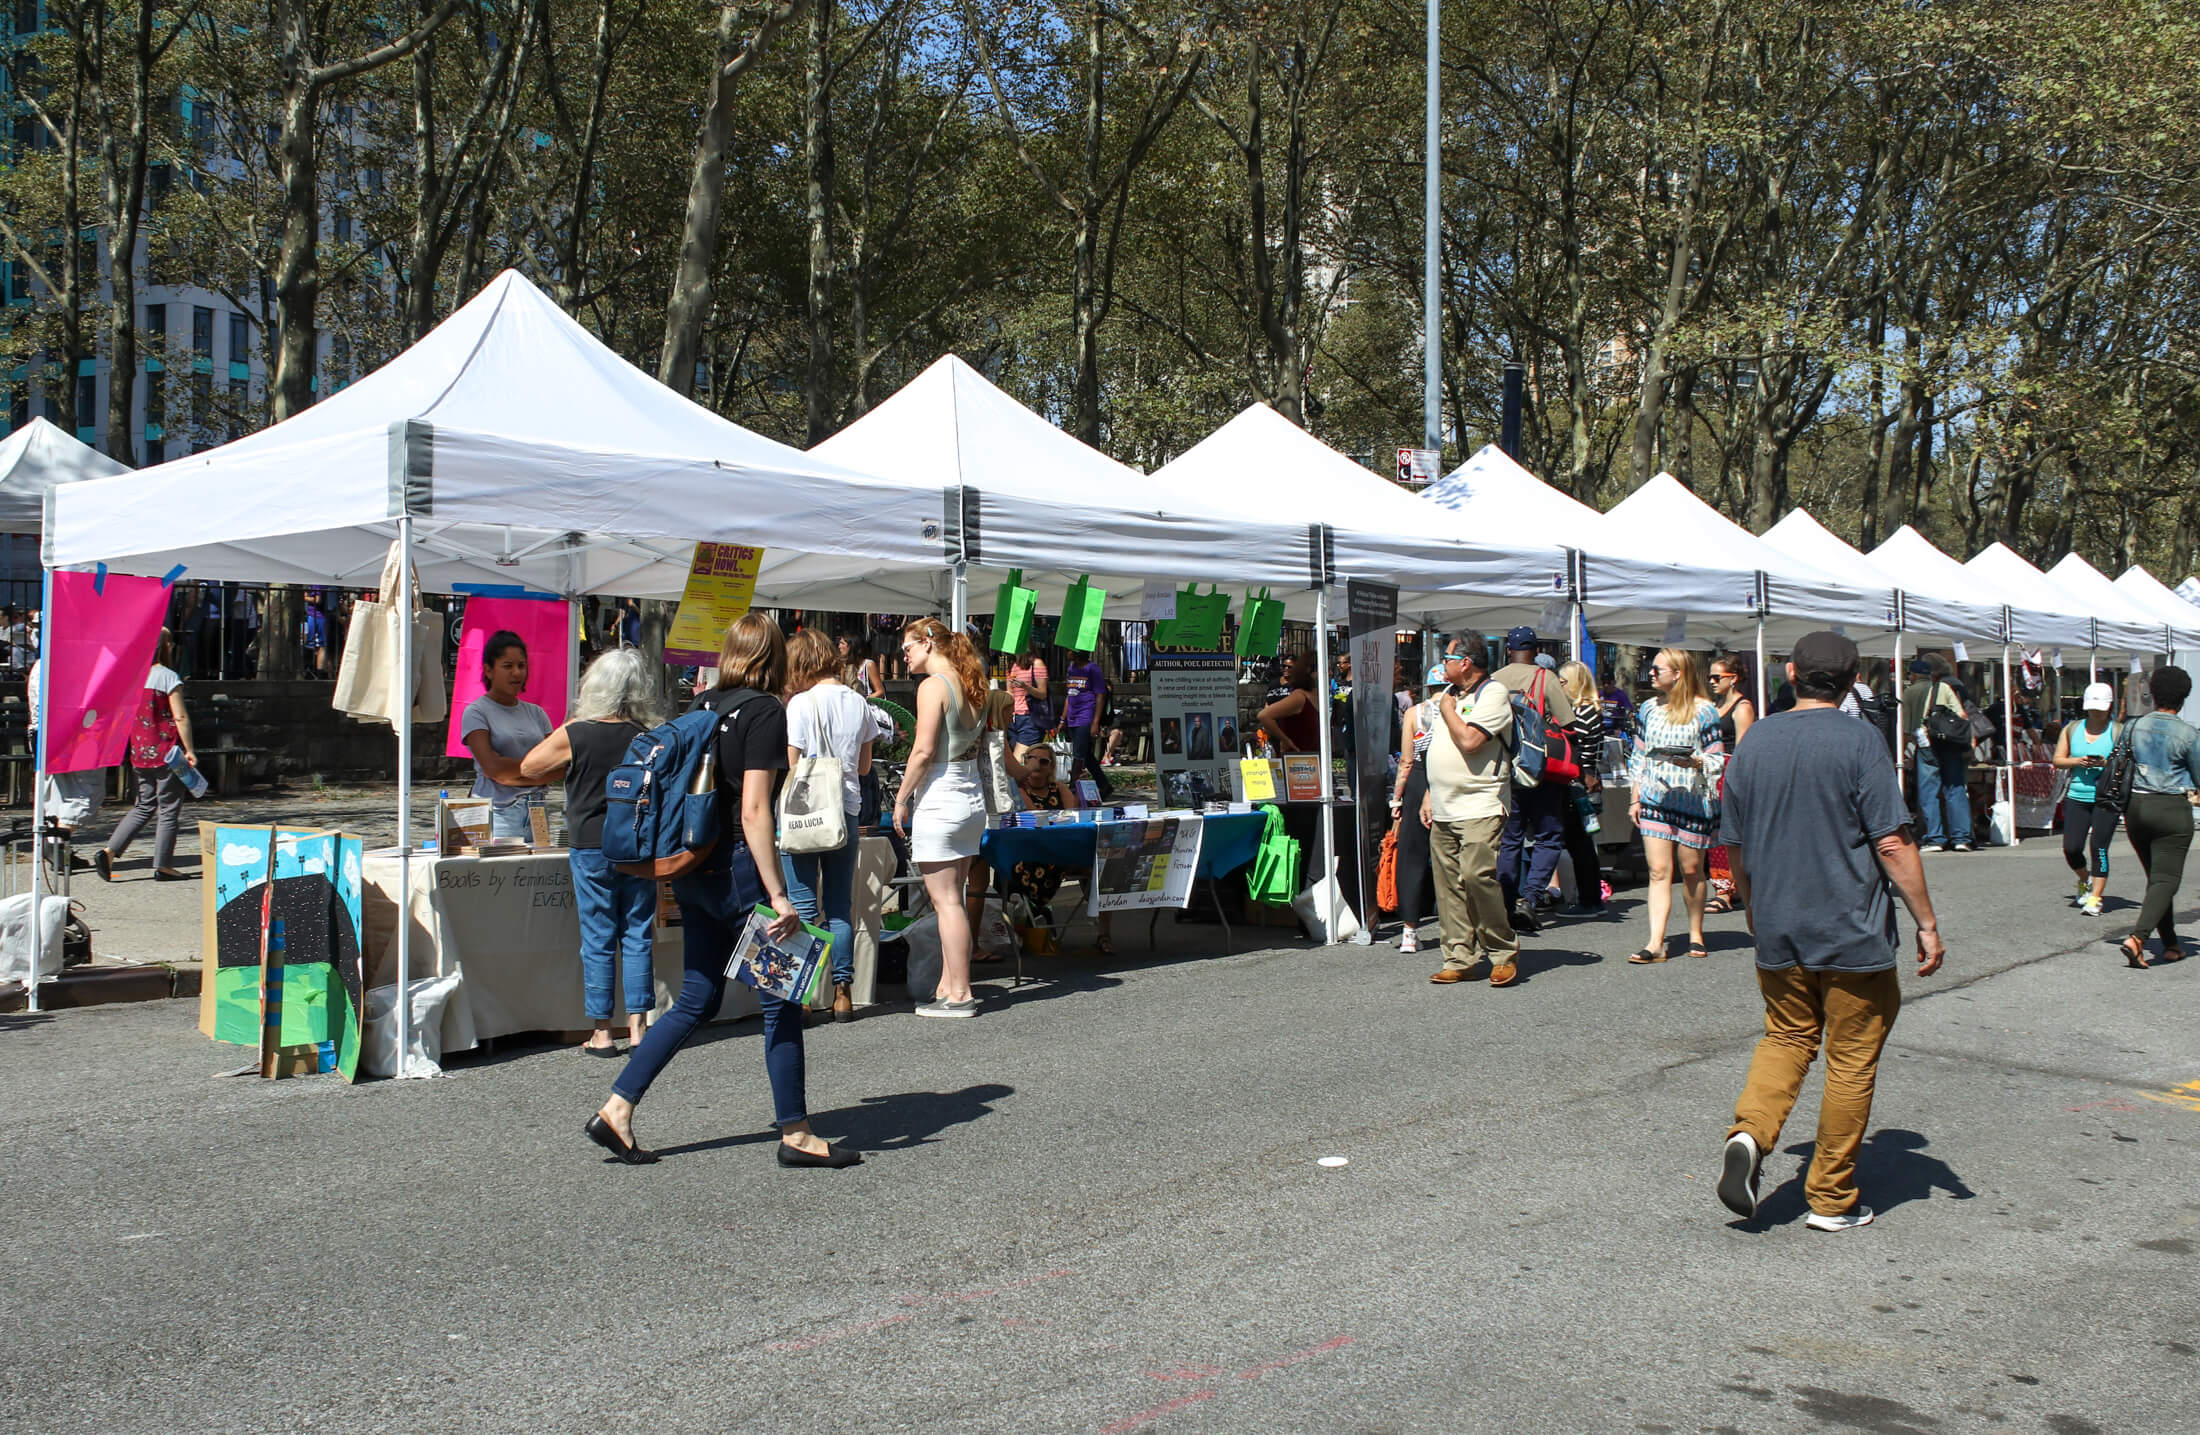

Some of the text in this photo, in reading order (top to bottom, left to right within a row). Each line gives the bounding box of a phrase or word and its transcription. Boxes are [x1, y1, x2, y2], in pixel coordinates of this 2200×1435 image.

[718, 545, 755, 560] CRITICS
[1155, 660, 1183, 669] AUTHOR,
[788, 816, 824, 830] READ LUCIA
[439, 866, 570, 896] Books by feminists
